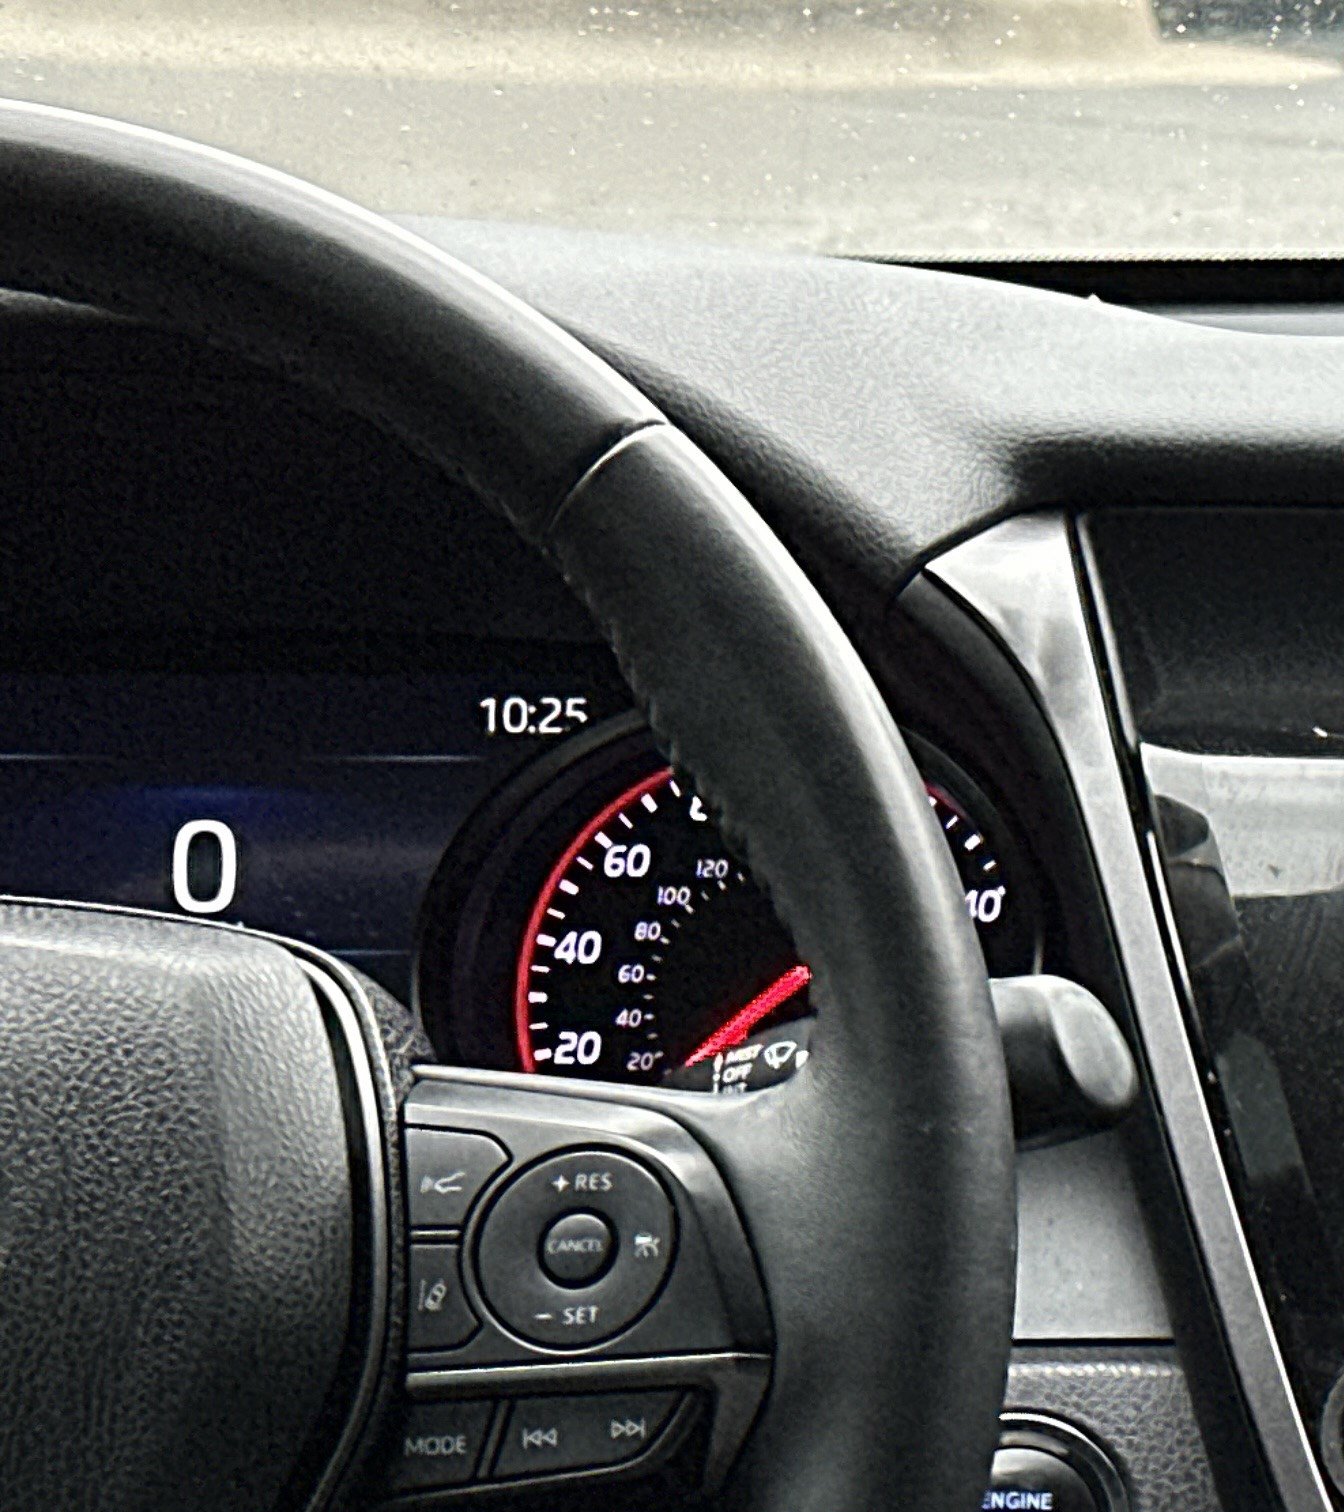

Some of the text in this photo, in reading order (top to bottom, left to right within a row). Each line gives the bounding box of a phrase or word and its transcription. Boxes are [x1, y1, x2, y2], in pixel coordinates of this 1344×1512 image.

[481, 698, 588, 735] 10:25
[173, 819, 237, 913] 0
[603, 844, 650, 878] 60
[696, 859, 729, 880] 120
[657, 885, 691, 906] 100
[635, 922, 662, 941] 80
[555, 930, 602, 965] 40
[618, 965, 645, 984] 60
[616, 1009, 642, 1028] 40
[554, 1031, 601, 1065] 20
[627, 1052, 655, 1072] 20
[575, 1173, 613, 1191] RES
[562, 1306, 599, 1325] SET
[405, 1434, 467, 1457] MODE
